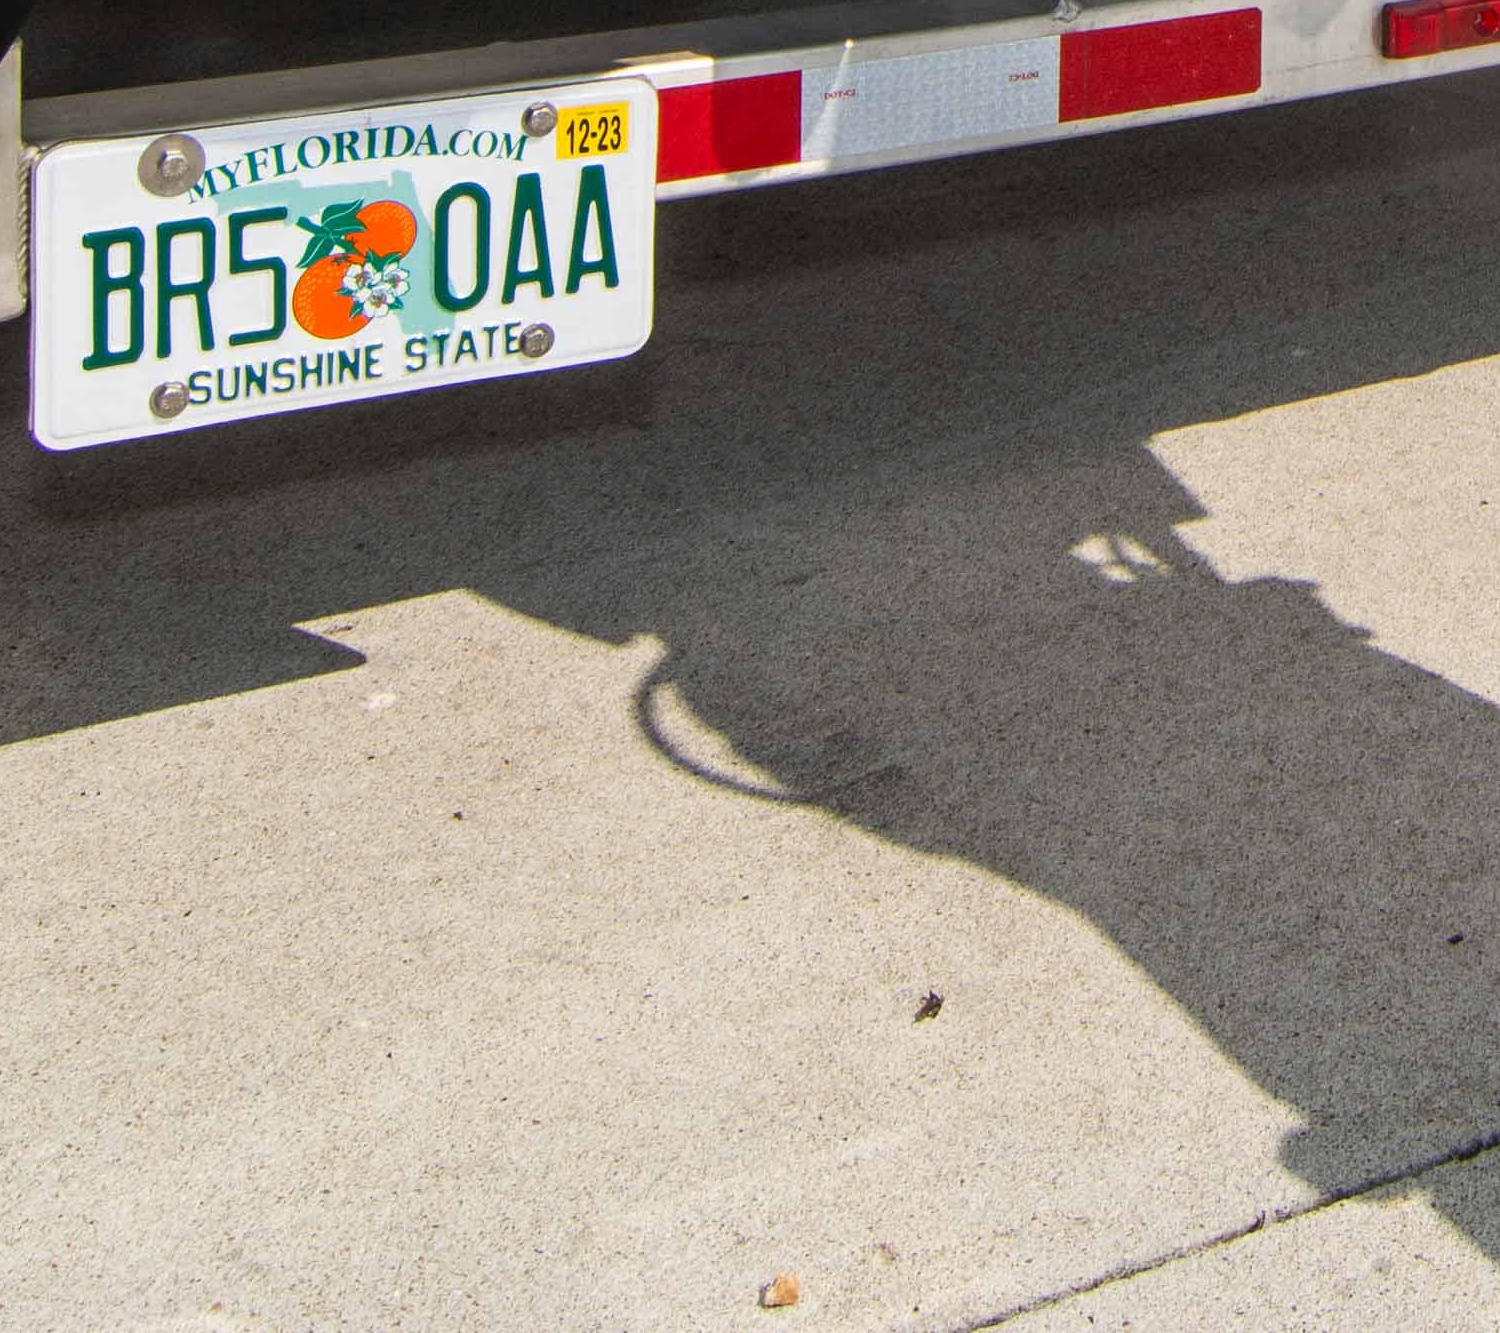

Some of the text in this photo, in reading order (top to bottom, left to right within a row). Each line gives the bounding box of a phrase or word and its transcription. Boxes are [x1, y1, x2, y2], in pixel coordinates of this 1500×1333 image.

[186, 123, 527, 204] MYFLORIDA.COM
[565, 115, 622, 155] 12-23
[82, 206, 288, 371] BR5
[188, 319, 525, 406] SUNSHINE STATE
